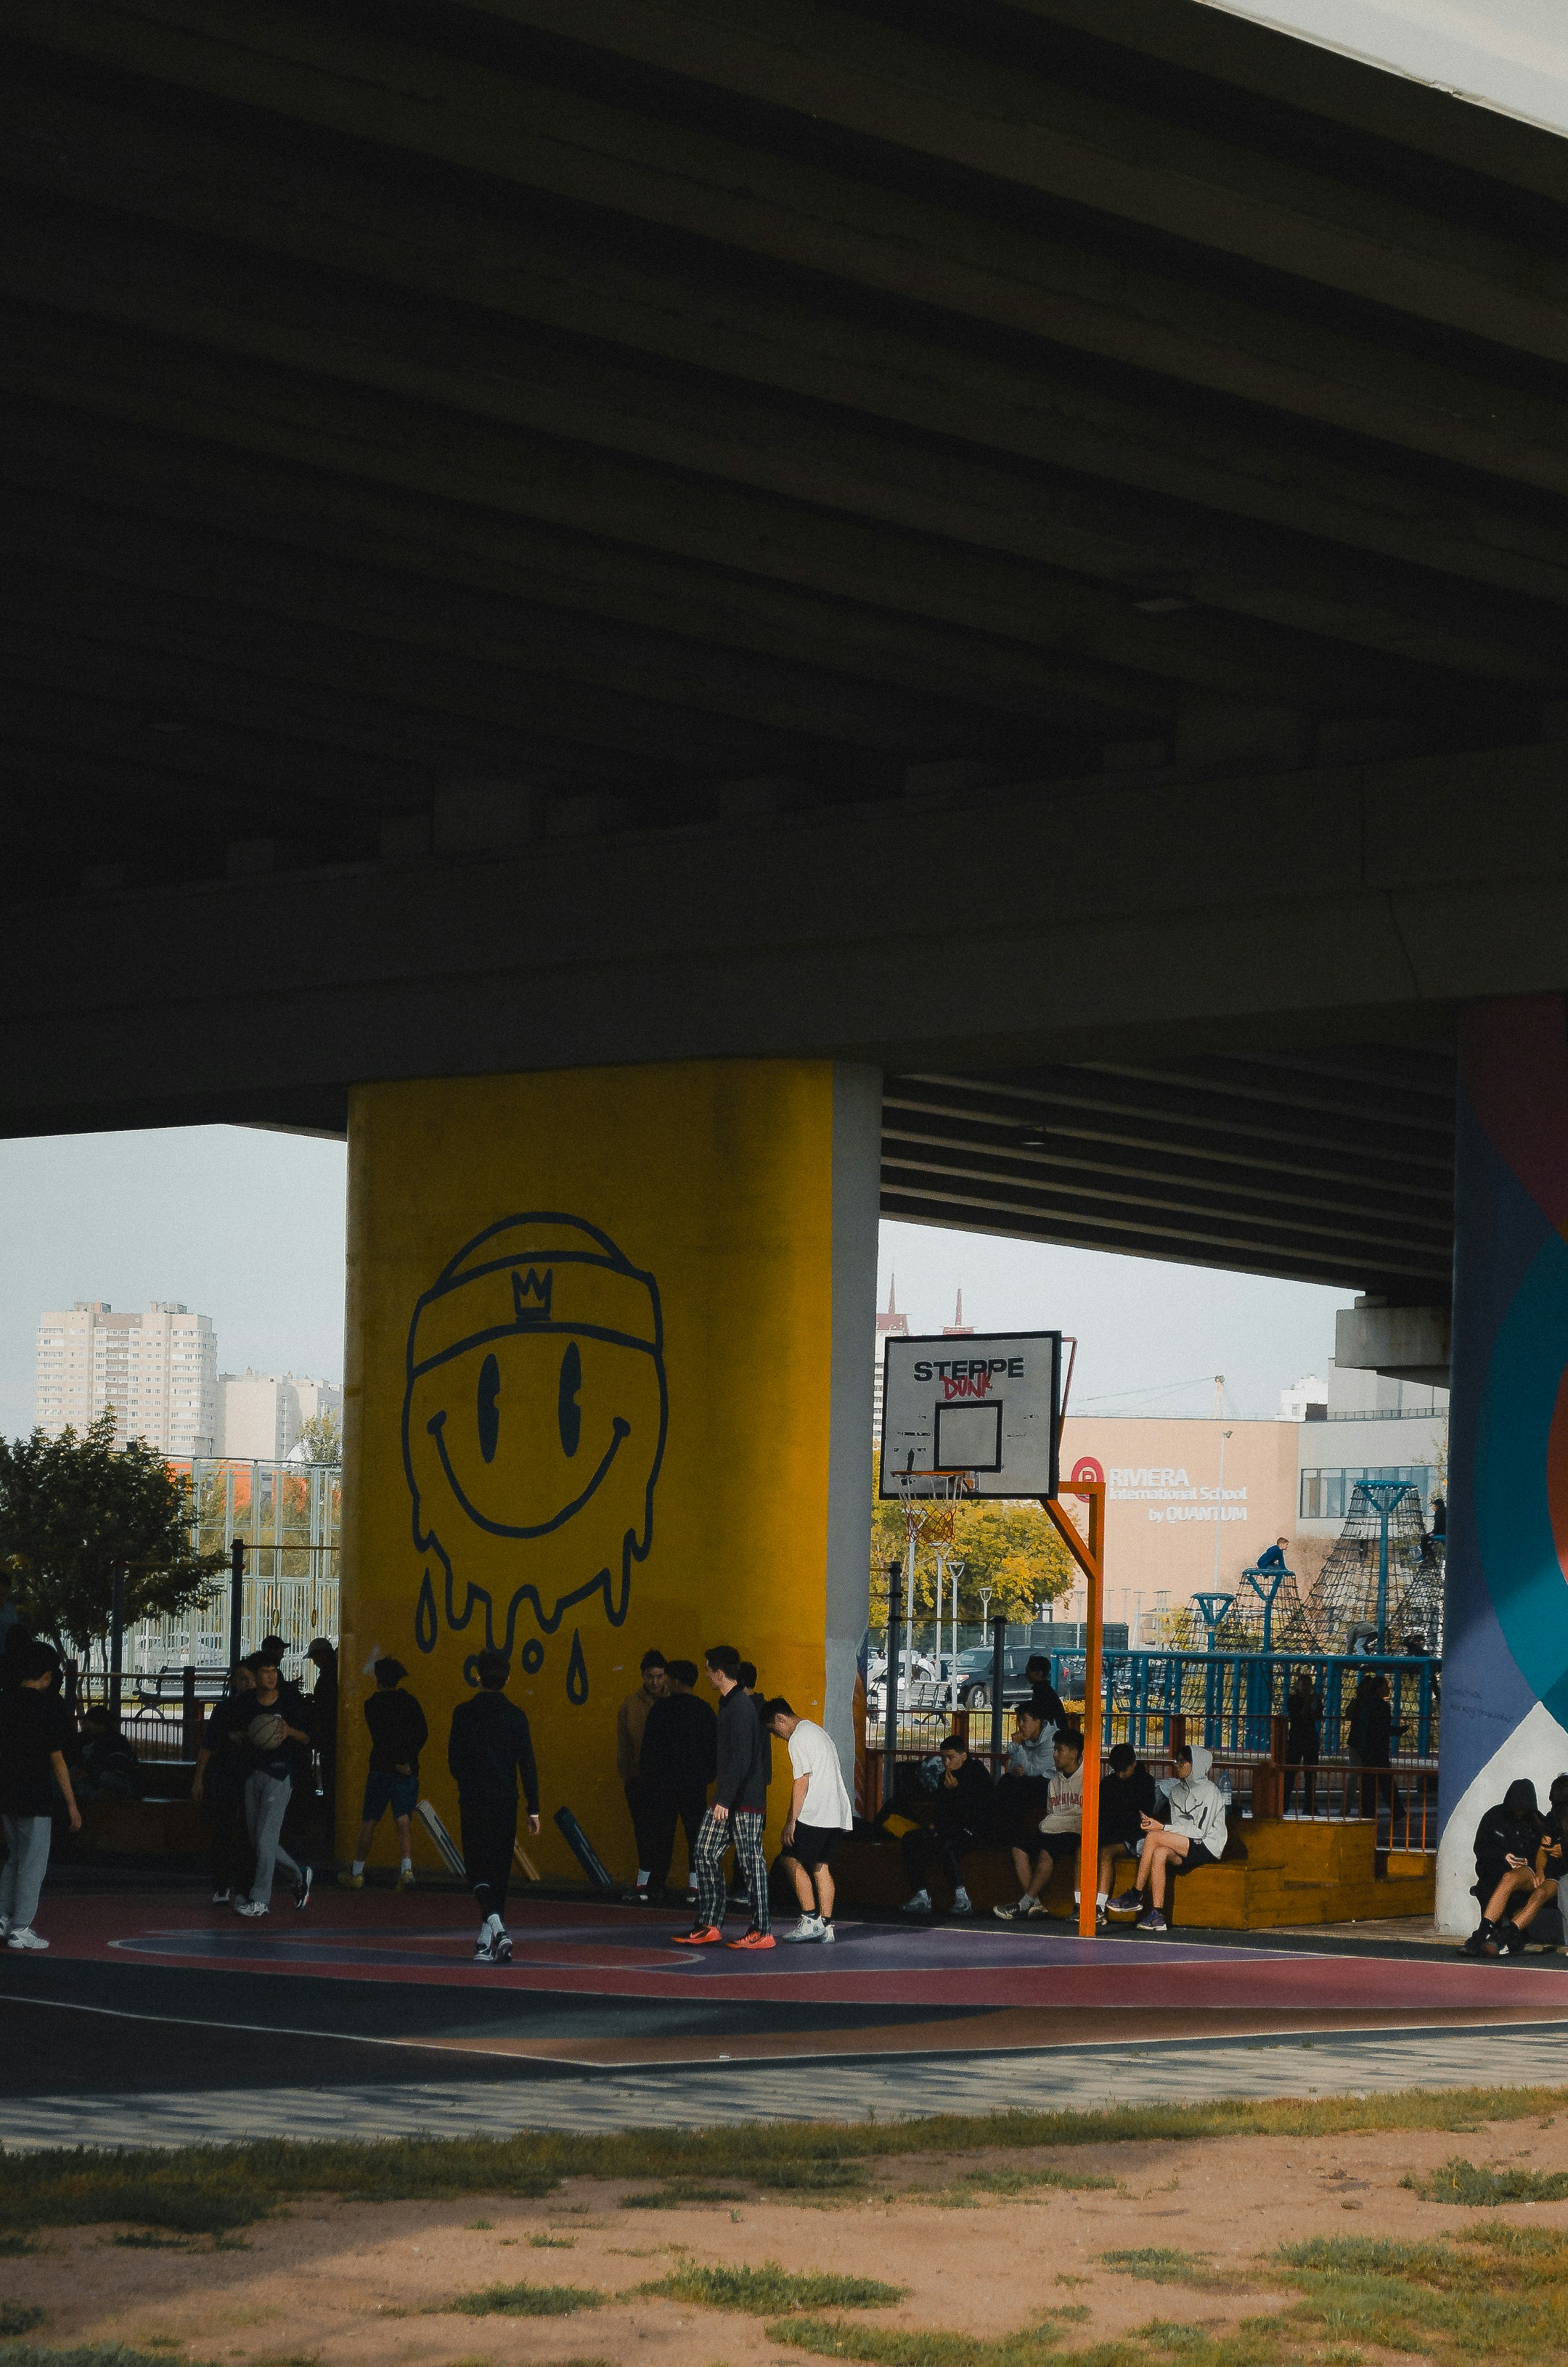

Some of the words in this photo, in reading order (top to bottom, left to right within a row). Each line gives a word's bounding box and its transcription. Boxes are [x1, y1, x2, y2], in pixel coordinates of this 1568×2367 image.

[913, 1357, 1024, 1382] STEPPE
[940, 1369, 993, 1400] DUNK
[1108, 1468, 1189, 1487] RIVIERA
[1109, 1487, 1197, 1500] International
[1200, 1487, 1248, 1501] School
[1148, 1508, 1164, 1524] by
[1166, 1506, 1248, 1524] QUANTUM
